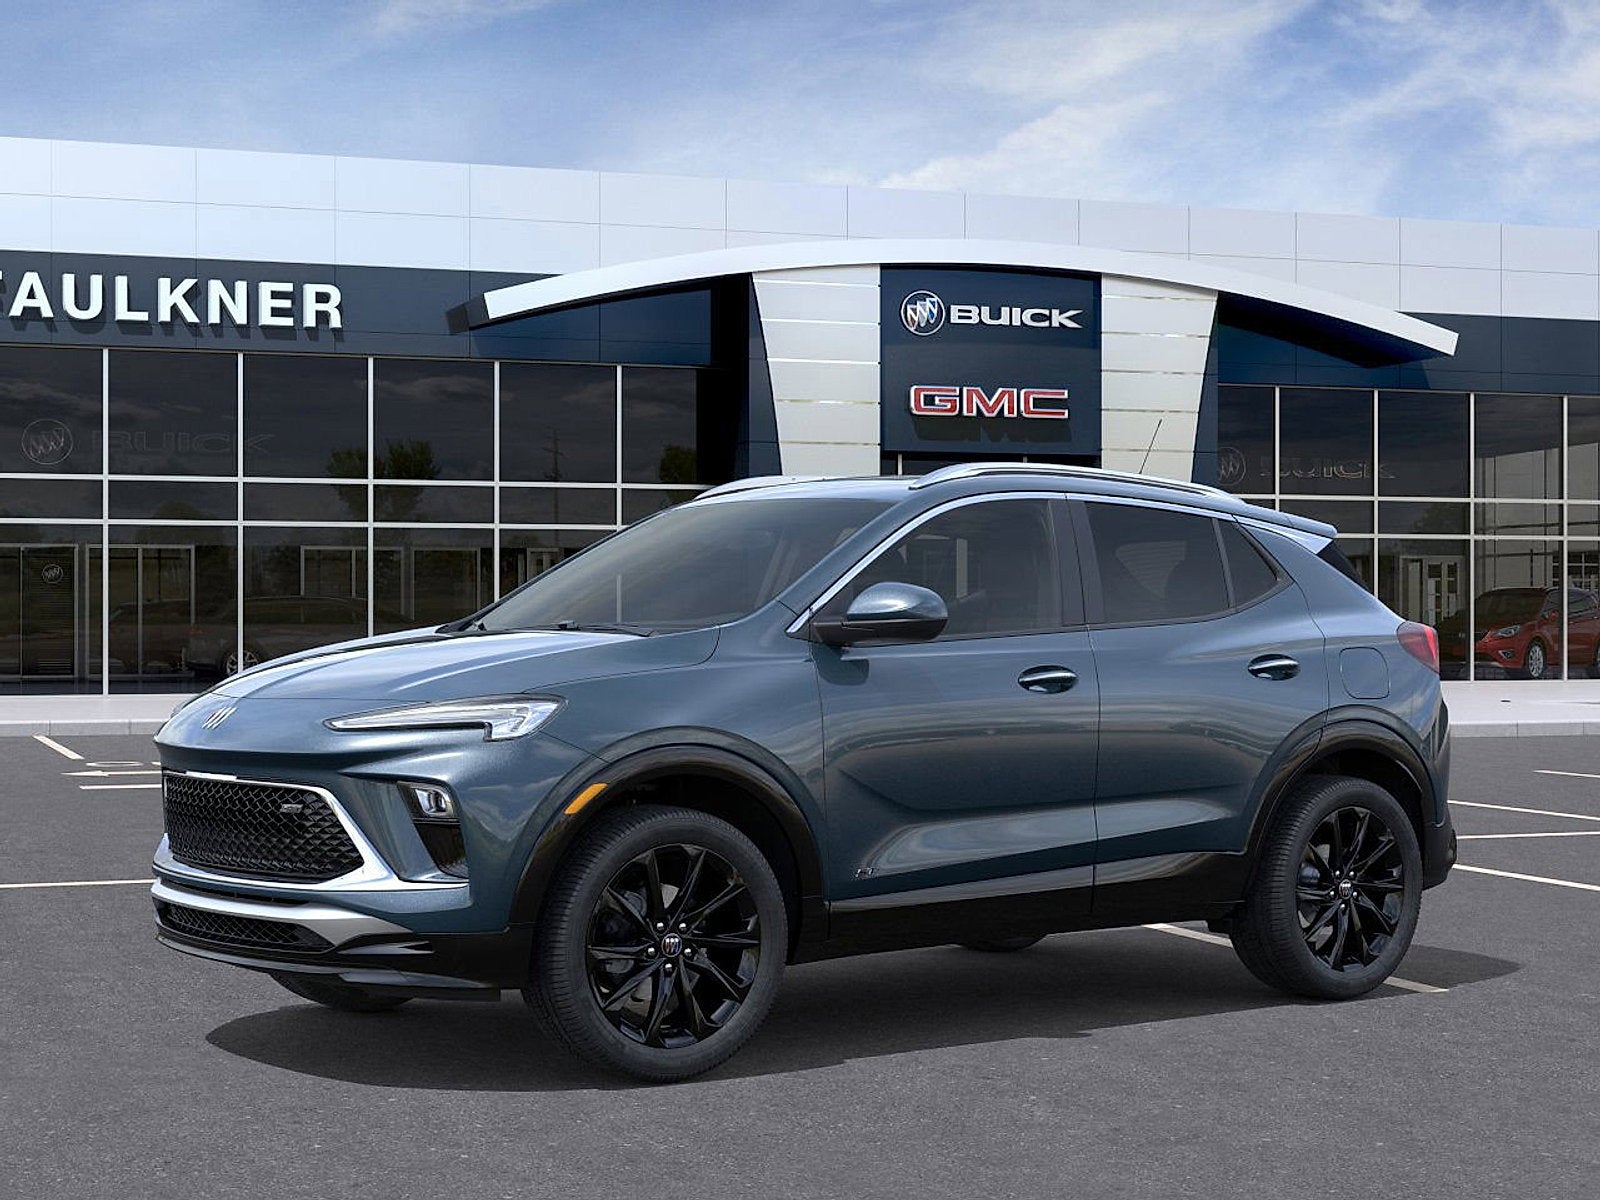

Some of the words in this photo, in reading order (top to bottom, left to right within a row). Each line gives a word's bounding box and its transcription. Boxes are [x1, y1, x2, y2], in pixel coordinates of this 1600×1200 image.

[0, 270, 343, 329] AULKNER
[950, 304, 1083, 329] BUICK
[909, 384, 1069, 419] GMC
